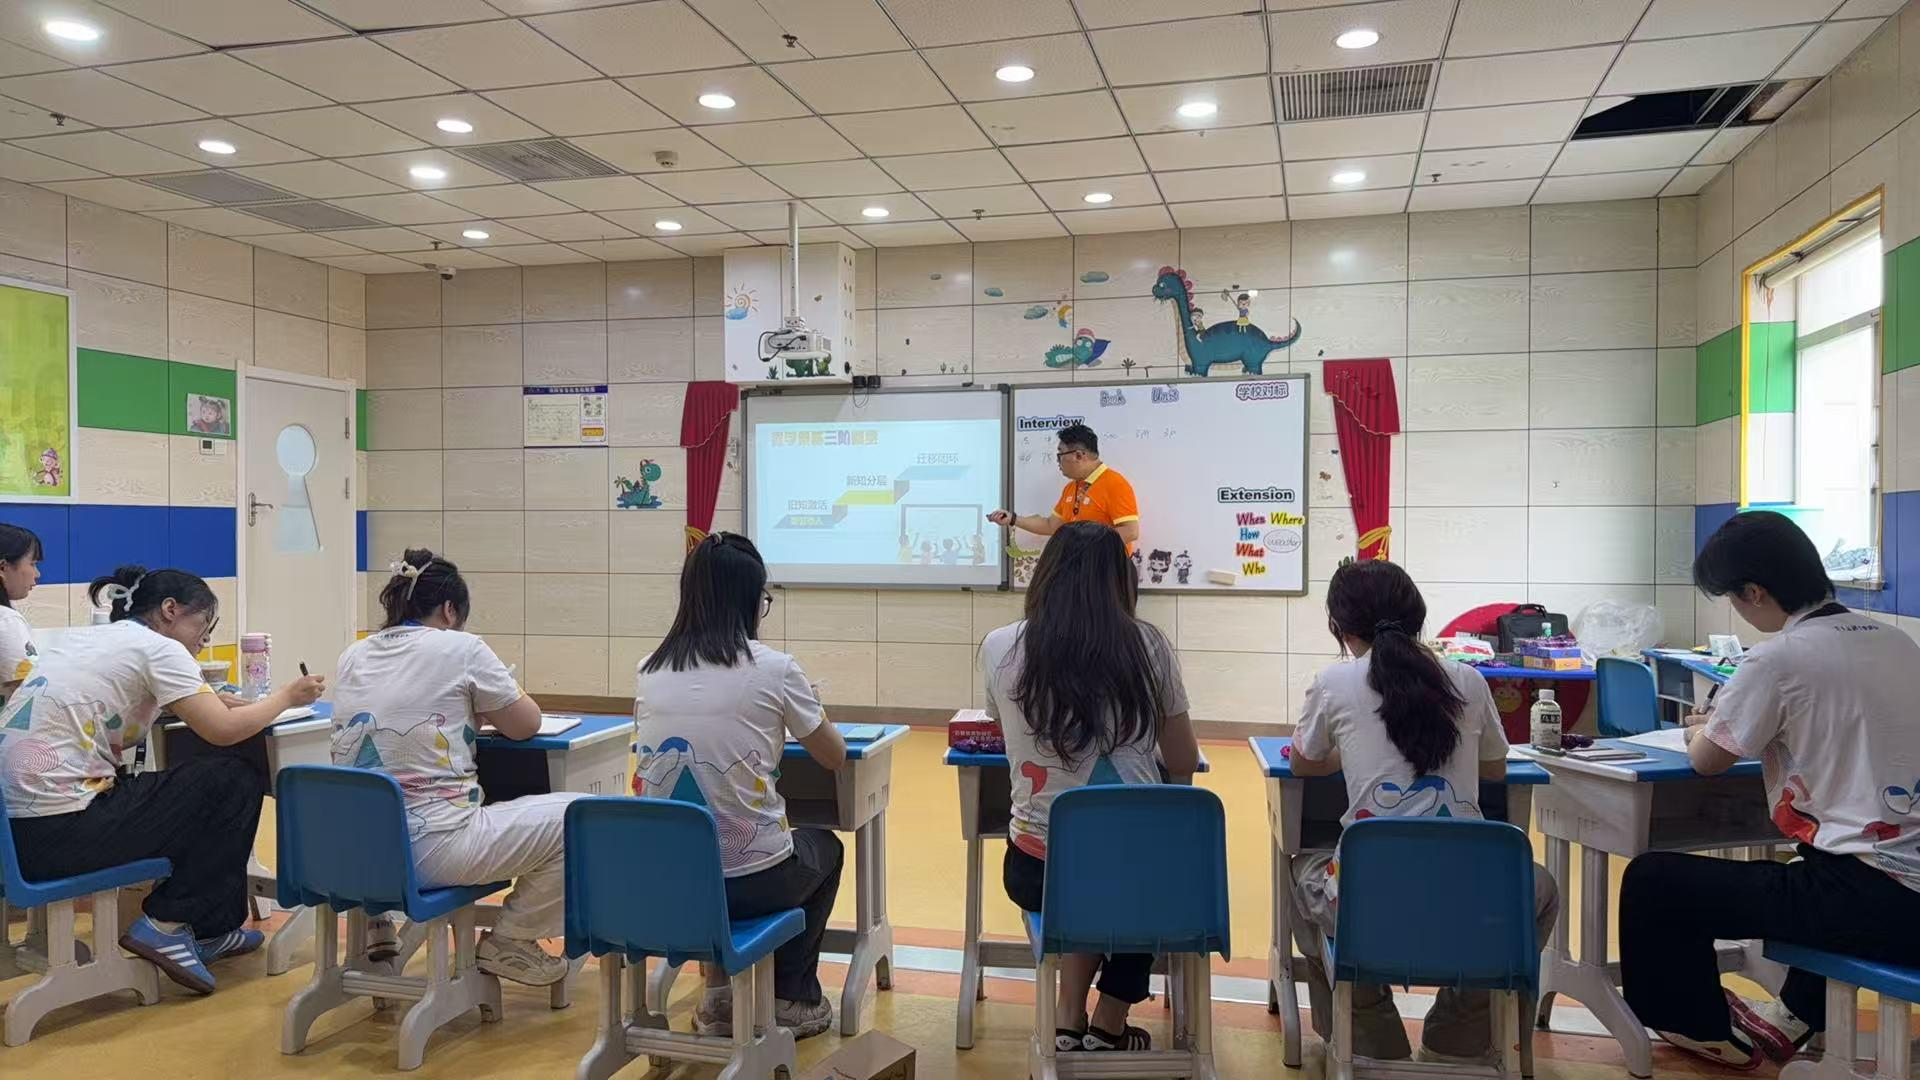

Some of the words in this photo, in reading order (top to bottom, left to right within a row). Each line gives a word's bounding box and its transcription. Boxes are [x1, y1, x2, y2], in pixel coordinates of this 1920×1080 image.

[1238, 384, 1287, 398] 学校对标
[1020, 417, 1082, 429] Interview
[1220, 489, 1292, 501] Extension
[1270, 512, 1304, 525] Where
[1240, 527, 1260, 541] How
[1236, 542, 1265, 557] What
[1242, 562, 1266, 576] Who
